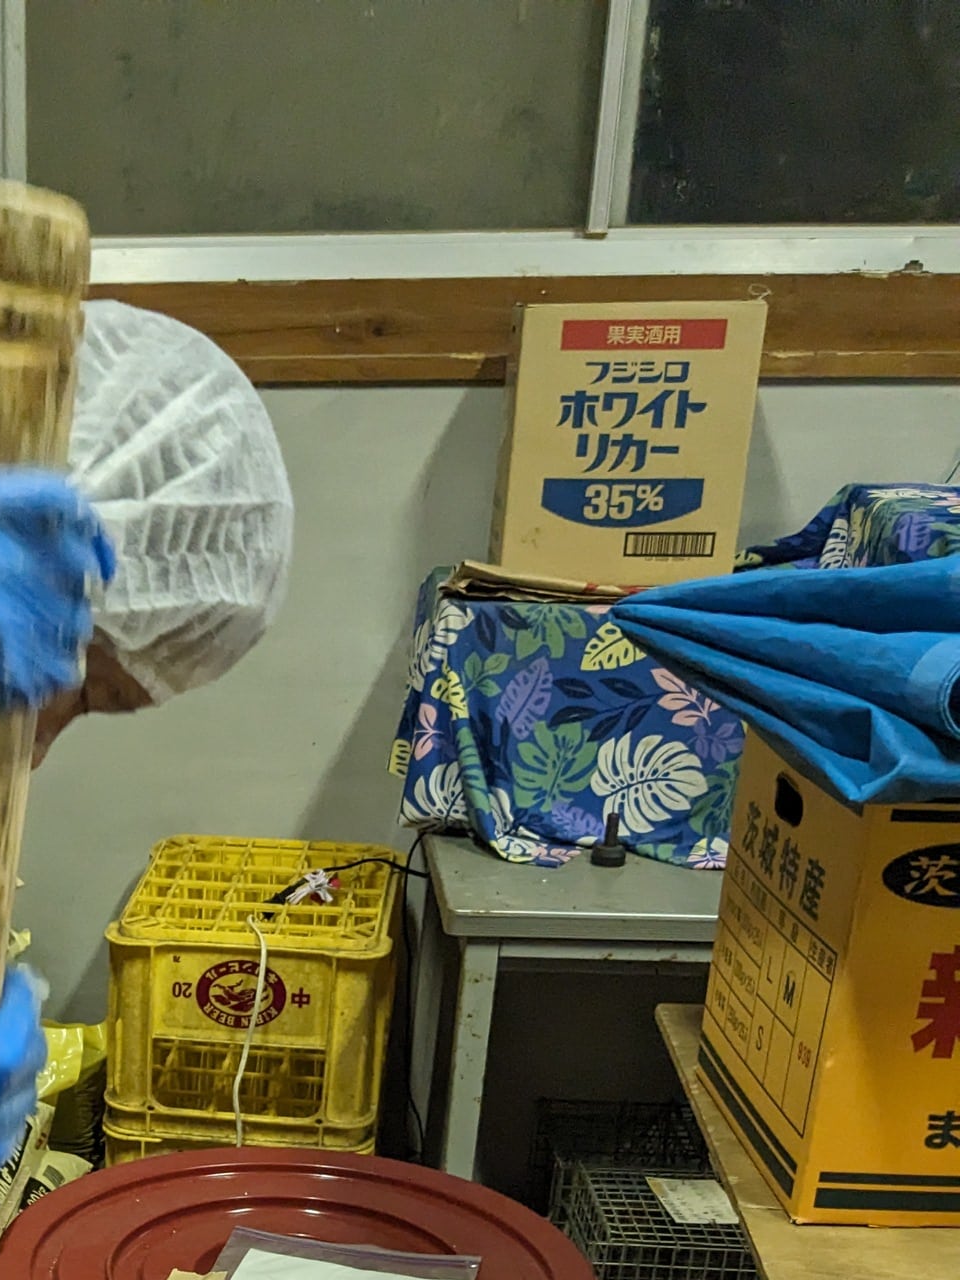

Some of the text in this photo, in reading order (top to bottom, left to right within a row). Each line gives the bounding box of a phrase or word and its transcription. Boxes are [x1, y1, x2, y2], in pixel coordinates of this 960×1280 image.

[606, 325, 682, 345] 果実酒用
[585, 360, 691, 385] フジシロ
[556, 389, 708, 429] ホワイト
[576, 433, 680, 473] リカー
[583, 483, 665, 520] 35%
[172, 981, 193, 998] 20
[290, 986, 311, 1009] 中
[783, 974, 796, 1009] M
[202, 1002, 236, 1027] BEER
